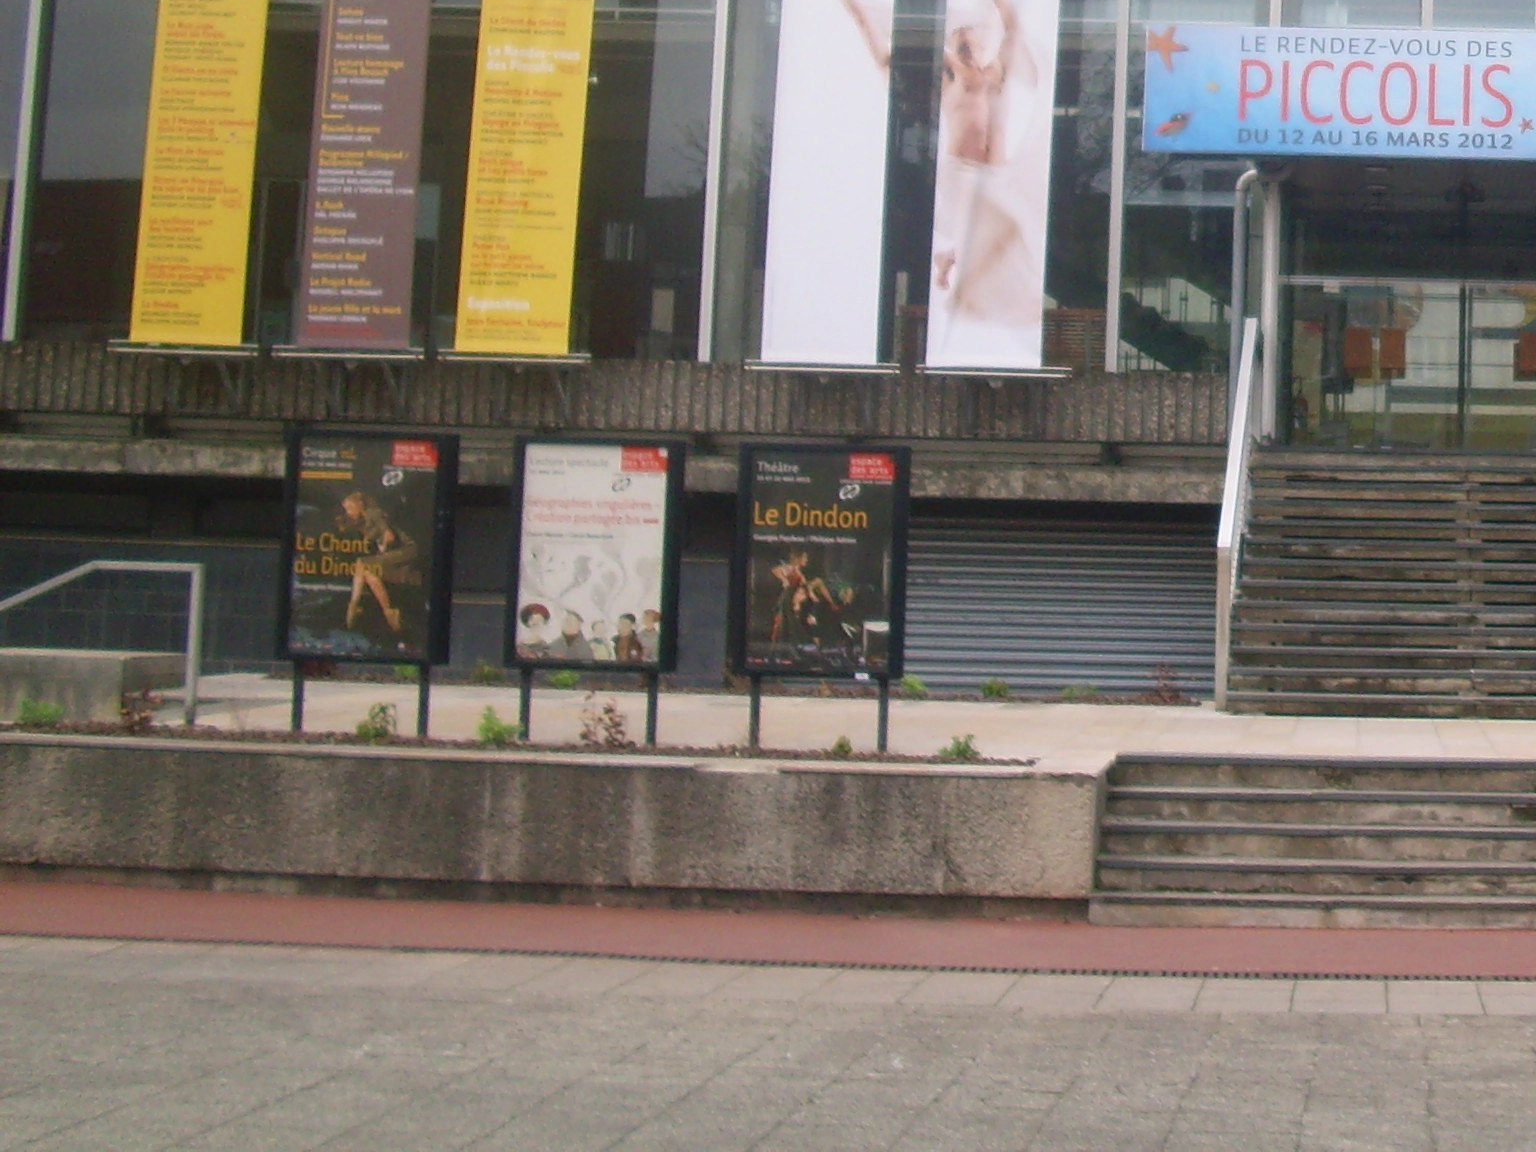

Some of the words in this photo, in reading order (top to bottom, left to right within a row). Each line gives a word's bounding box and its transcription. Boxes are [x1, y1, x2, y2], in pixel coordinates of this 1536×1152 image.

[1240, 36, 1268, 54] LE
[1276, 36, 1458, 57] RENDEZ-VOUS
[1466, 38, 1513, 58] DES
[1238, 58, 1514, 129] PICCOLIS
[1237, 128, 1270, 146] DU
[1277, 129, 1305, 146] 12
[1311, 130, 1345, 147] AU
[1351, 130, 1379, 147] 16
[1386, 131, 1450, 148] MARS
[1457, 133, 1514, 150] 2012
[757, 460, 800, 473] Théâtre
[753, 501, 780, 526] Le
[785, 501, 868, 529] Dindon
[296, 533, 315, 550] Le
[319, 533, 371, 553] Chant
[294, 554, 316, 574] du
